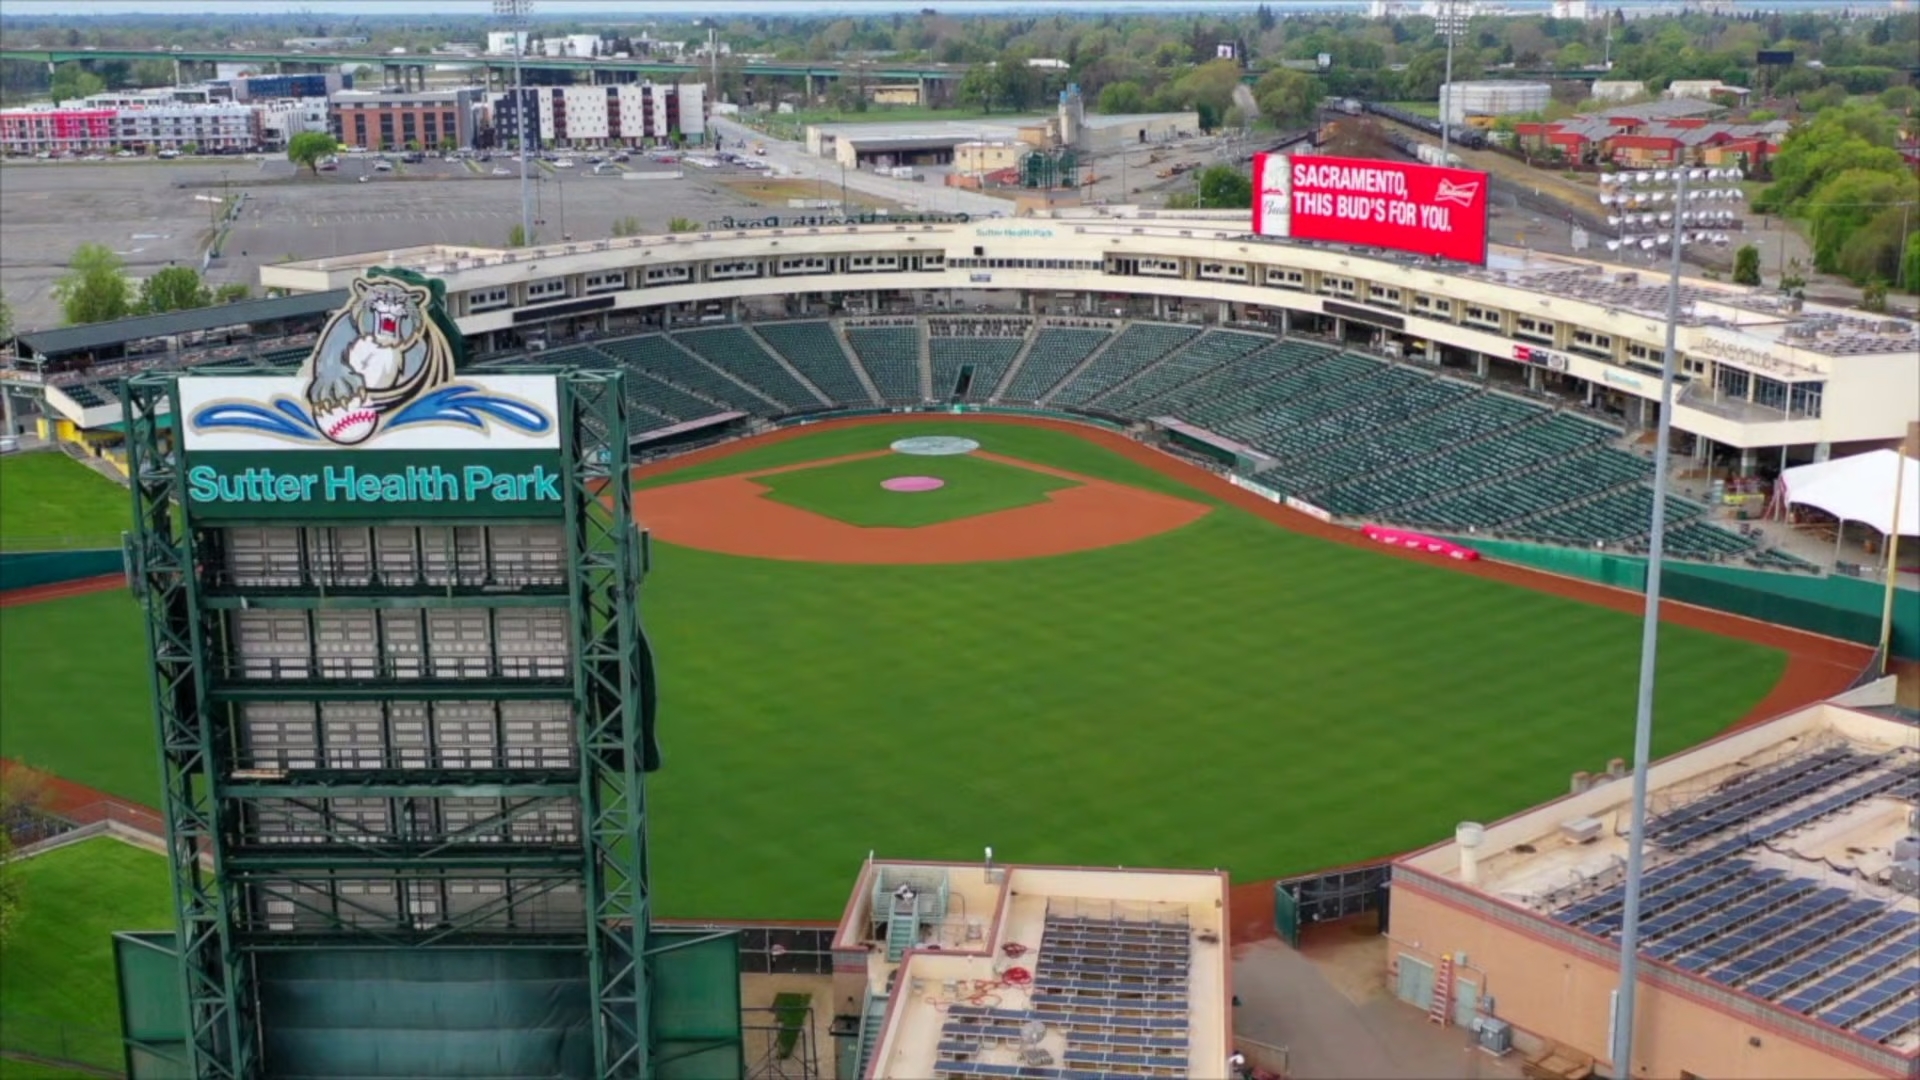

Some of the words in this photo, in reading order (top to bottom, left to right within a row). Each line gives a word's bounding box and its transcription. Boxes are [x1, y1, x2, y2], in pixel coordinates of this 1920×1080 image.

[1294, 164, 1408, 200] SACRAMENTO,
[1293, 191, 1333, 217] THIS
[1336, 195, 1386, 222] BUD'S
[1388, 200, 1417, 227] FOR
[1420, 204, 1453, 232] YOU.
[189, 465, 318, 501] Sutter
[323, 465, 459, 501] Health
[463, 465, 561, 501] Park
